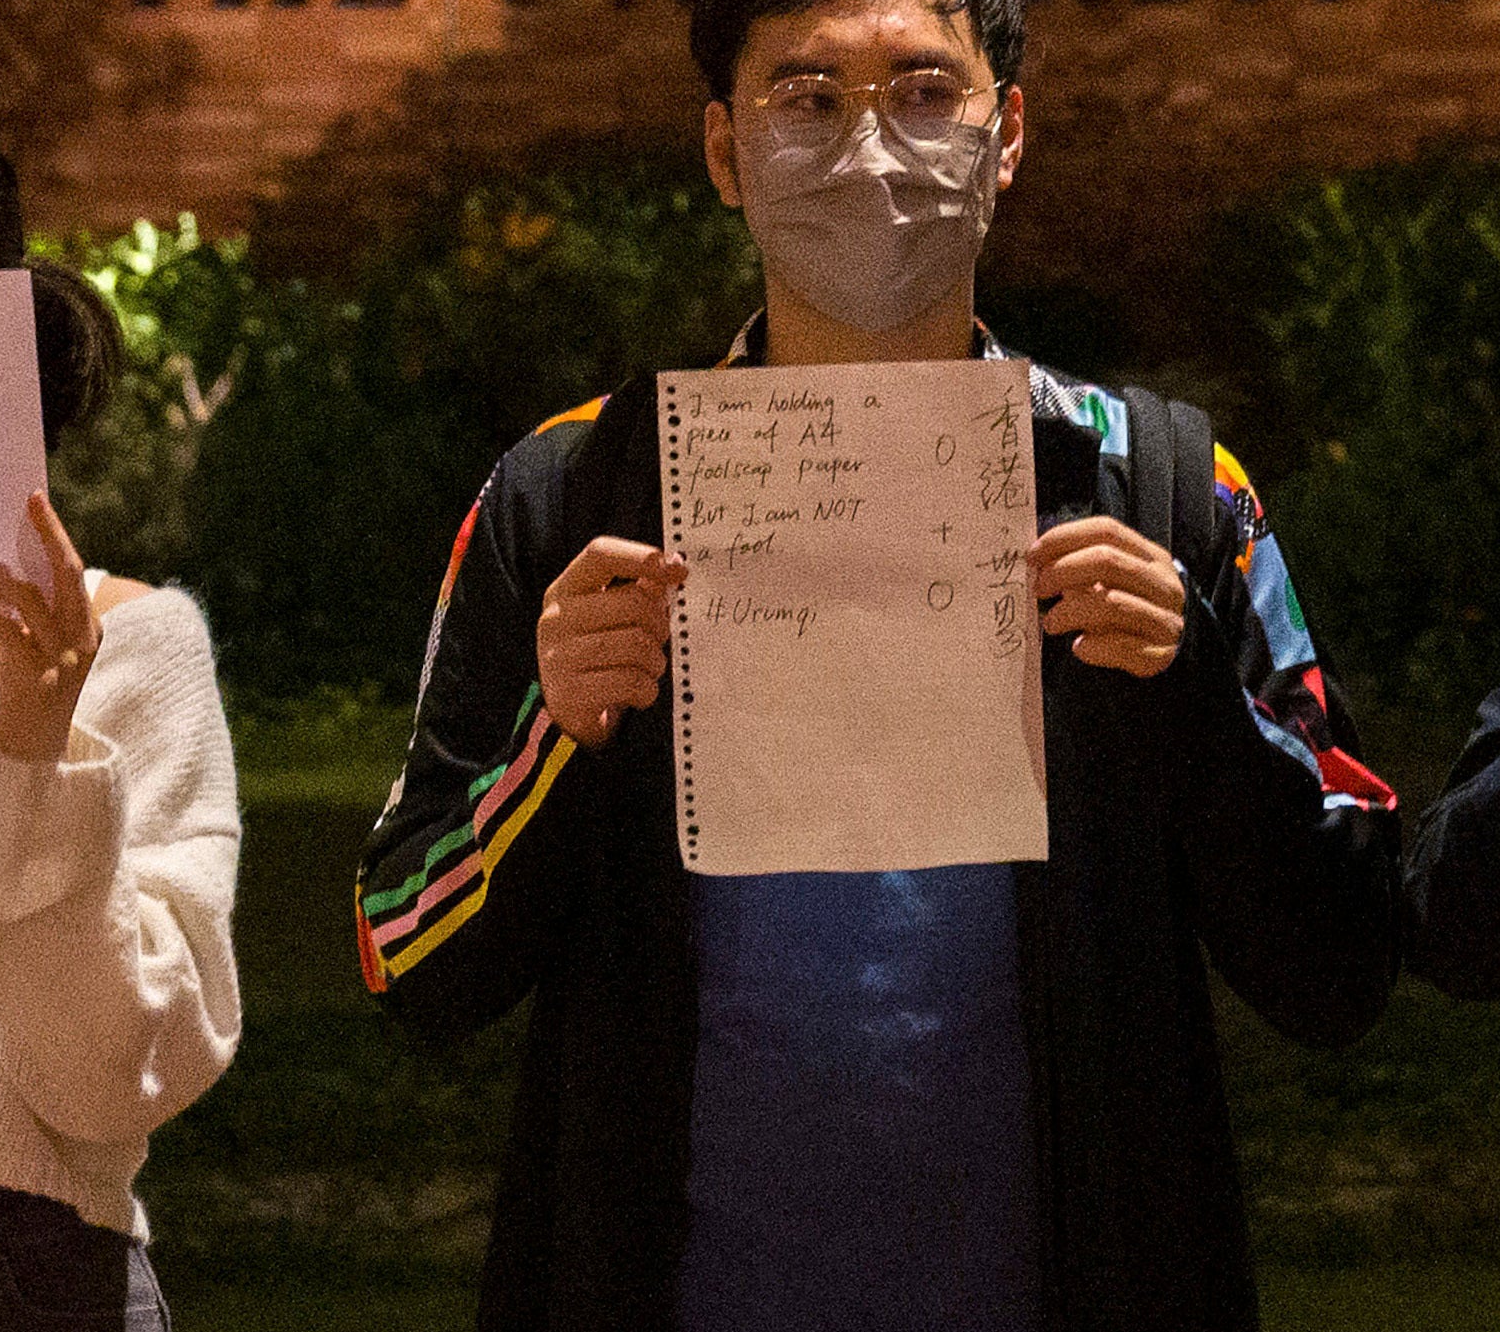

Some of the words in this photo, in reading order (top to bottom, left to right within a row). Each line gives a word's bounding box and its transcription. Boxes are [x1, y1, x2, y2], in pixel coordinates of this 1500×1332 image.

[718, 400, 752, 414] am
[767, 390, 834, 421] holding
[864, 395, 881, 409] a
[753, 420, 779, 454] of
[800, 419, 842, 447] A4
[688, 455, 772, 496] foolscap
[800, 457, 863, 485] paper
[691, 497, 726, 529] But
[765, 507, 801, 523] am
[813, 498, 866, 523] NOT
[697, 548, 712, 562] a
